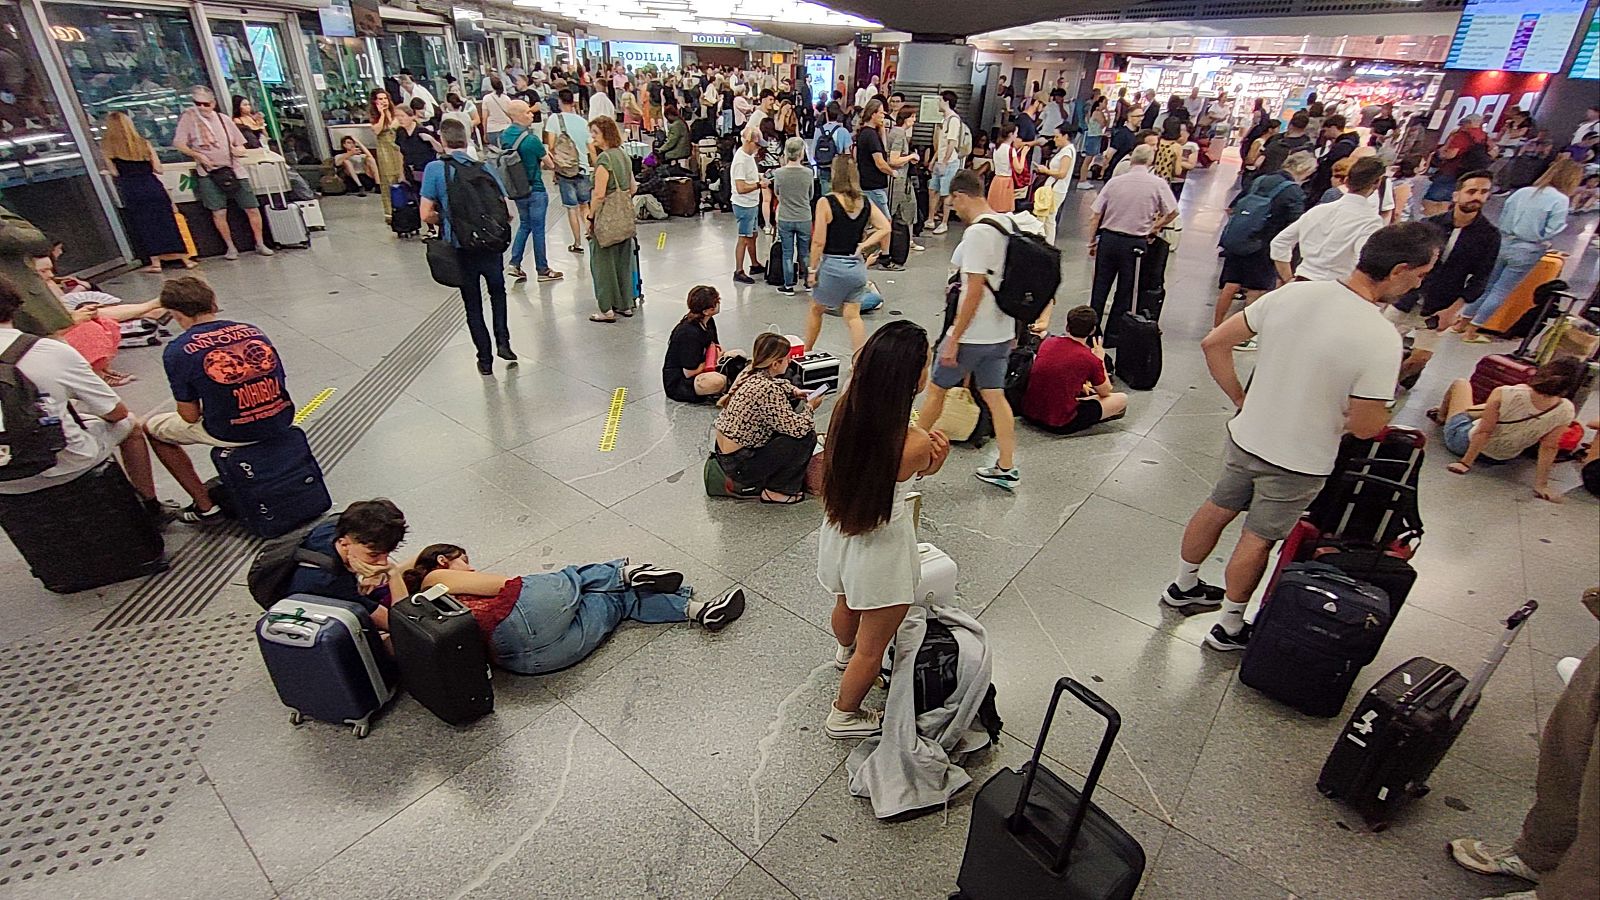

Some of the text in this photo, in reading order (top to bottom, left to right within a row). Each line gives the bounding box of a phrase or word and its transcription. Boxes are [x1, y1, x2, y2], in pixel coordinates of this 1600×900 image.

[692, 34, 736, 45] RODILLA
[617, 51, 673, 62] RODILLA
[355, 53, 372, 78] 12
